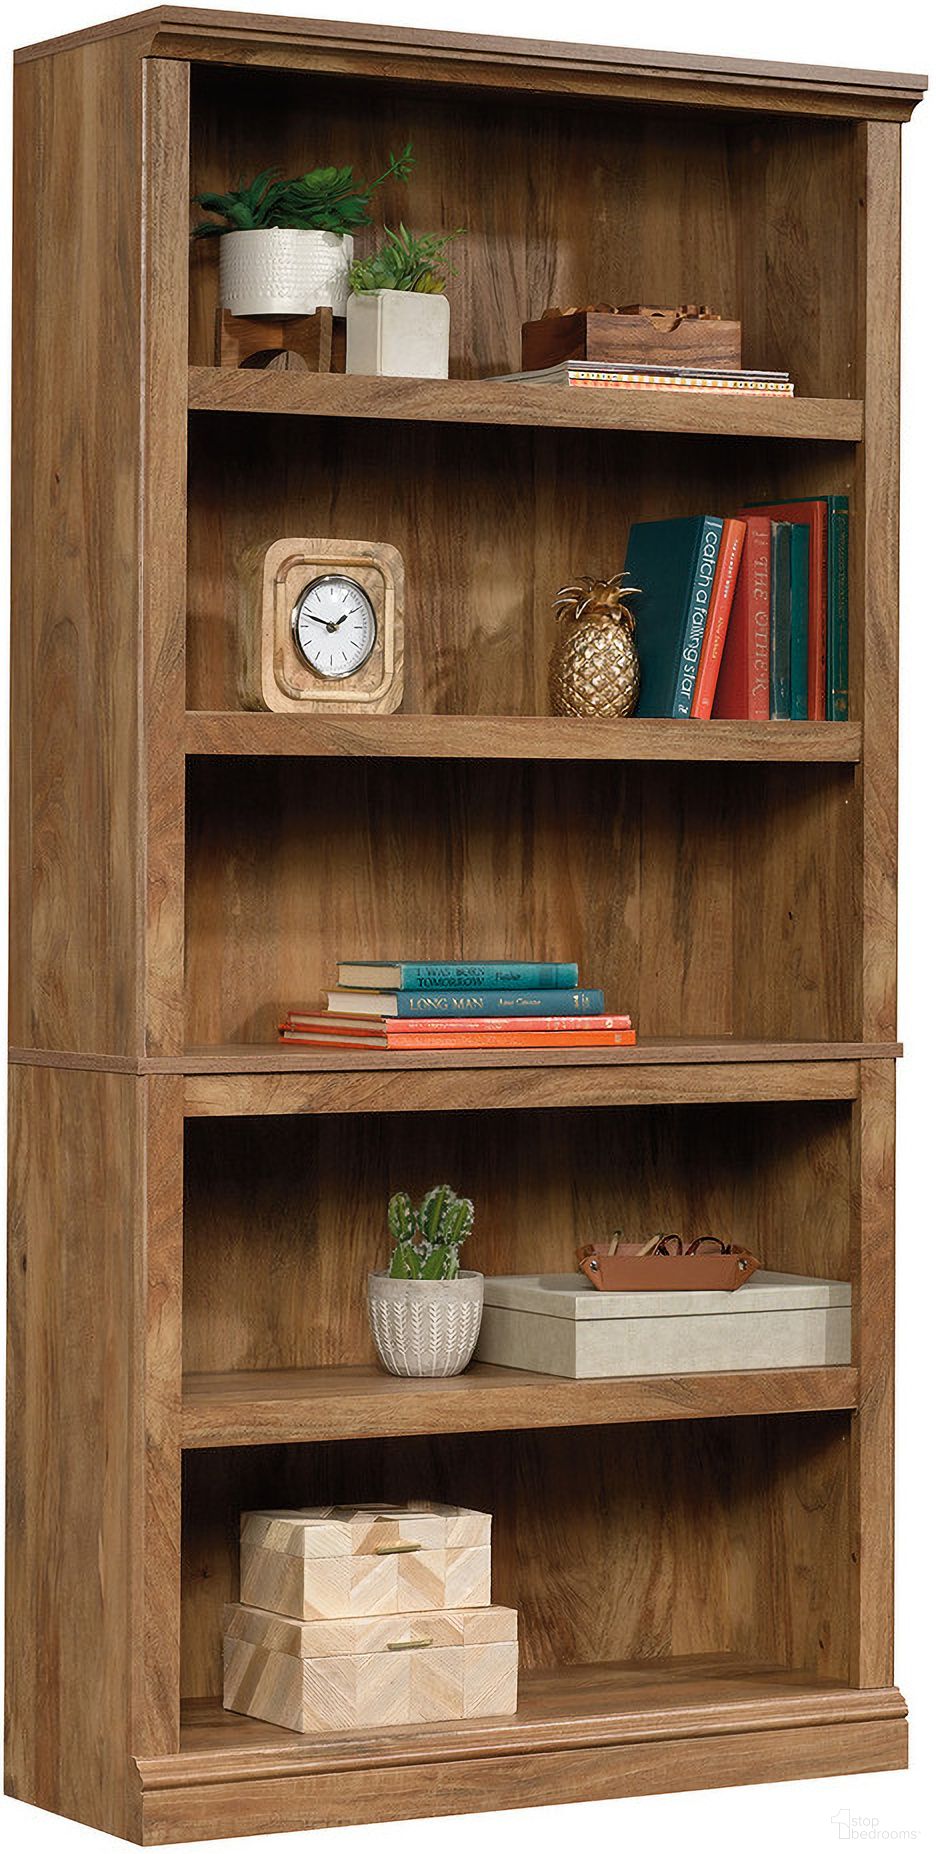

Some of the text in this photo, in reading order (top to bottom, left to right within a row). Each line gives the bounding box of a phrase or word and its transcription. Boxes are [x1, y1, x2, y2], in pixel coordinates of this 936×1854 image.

[693, 531, 718, 587] catch
[693, 590, 708, 605] a
[683, 606, 708, 663] falling
[752, 557, 769, 694] THE OTHER
[681, 664, 695, 699] star
[417, 977, 485, 987] TOMORROW
[409, 996, 449, 1010] LONG
[451, 996, 485, 1009] MAN
